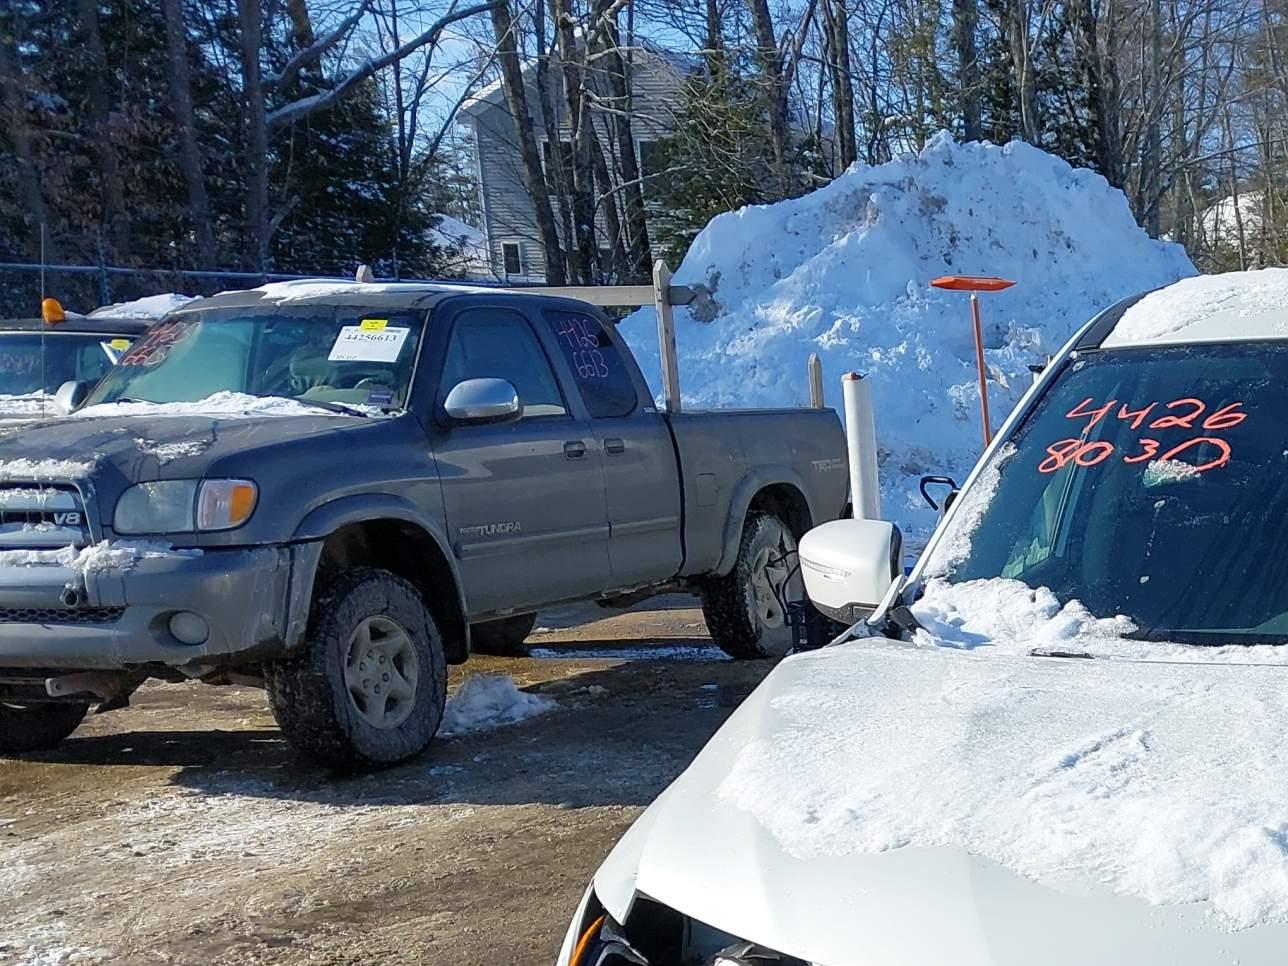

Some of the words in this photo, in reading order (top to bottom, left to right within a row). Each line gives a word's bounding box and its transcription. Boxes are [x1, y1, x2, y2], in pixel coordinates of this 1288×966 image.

[573, 349, 608, 378] 6613
[1066, 398, 1248, 432] 4426
[1038, 436, 1232, 473] 8030
[53, 511, 81, 525] V8
